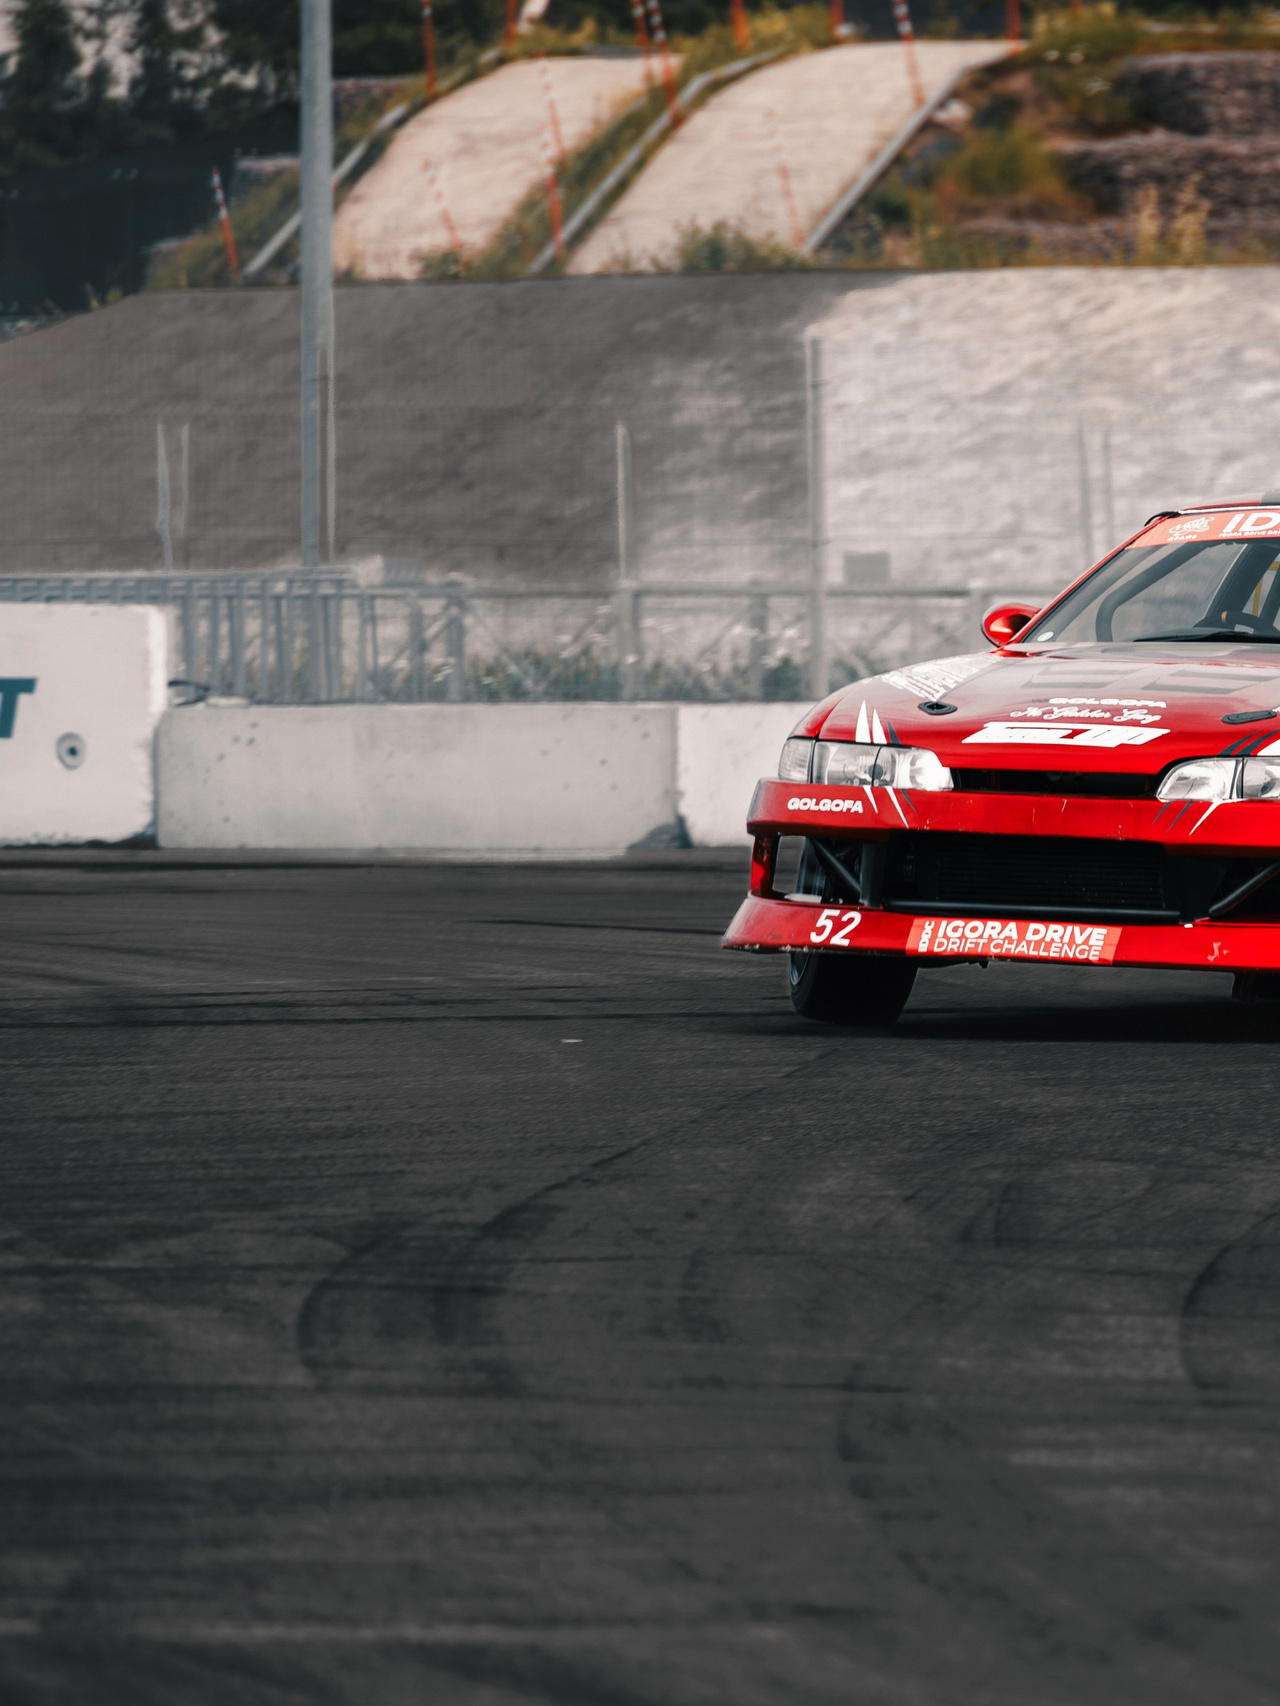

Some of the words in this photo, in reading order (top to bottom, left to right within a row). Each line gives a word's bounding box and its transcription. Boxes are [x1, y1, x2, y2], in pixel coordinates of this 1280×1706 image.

[1048, 698, 1167, 708] GOLGOFA
[787, 797, 864, 814] GOLGOFA
[810, 909, 862, 947] 52
[917, 920, 935, 953] IDDC
[937, 920, 1017, 940] IGORA
[1025, 923, 1108, 946] DRIVE
[934, 938, 987, 953] DRIFT
[989, 940, 1102, 961] CHALLENGE
